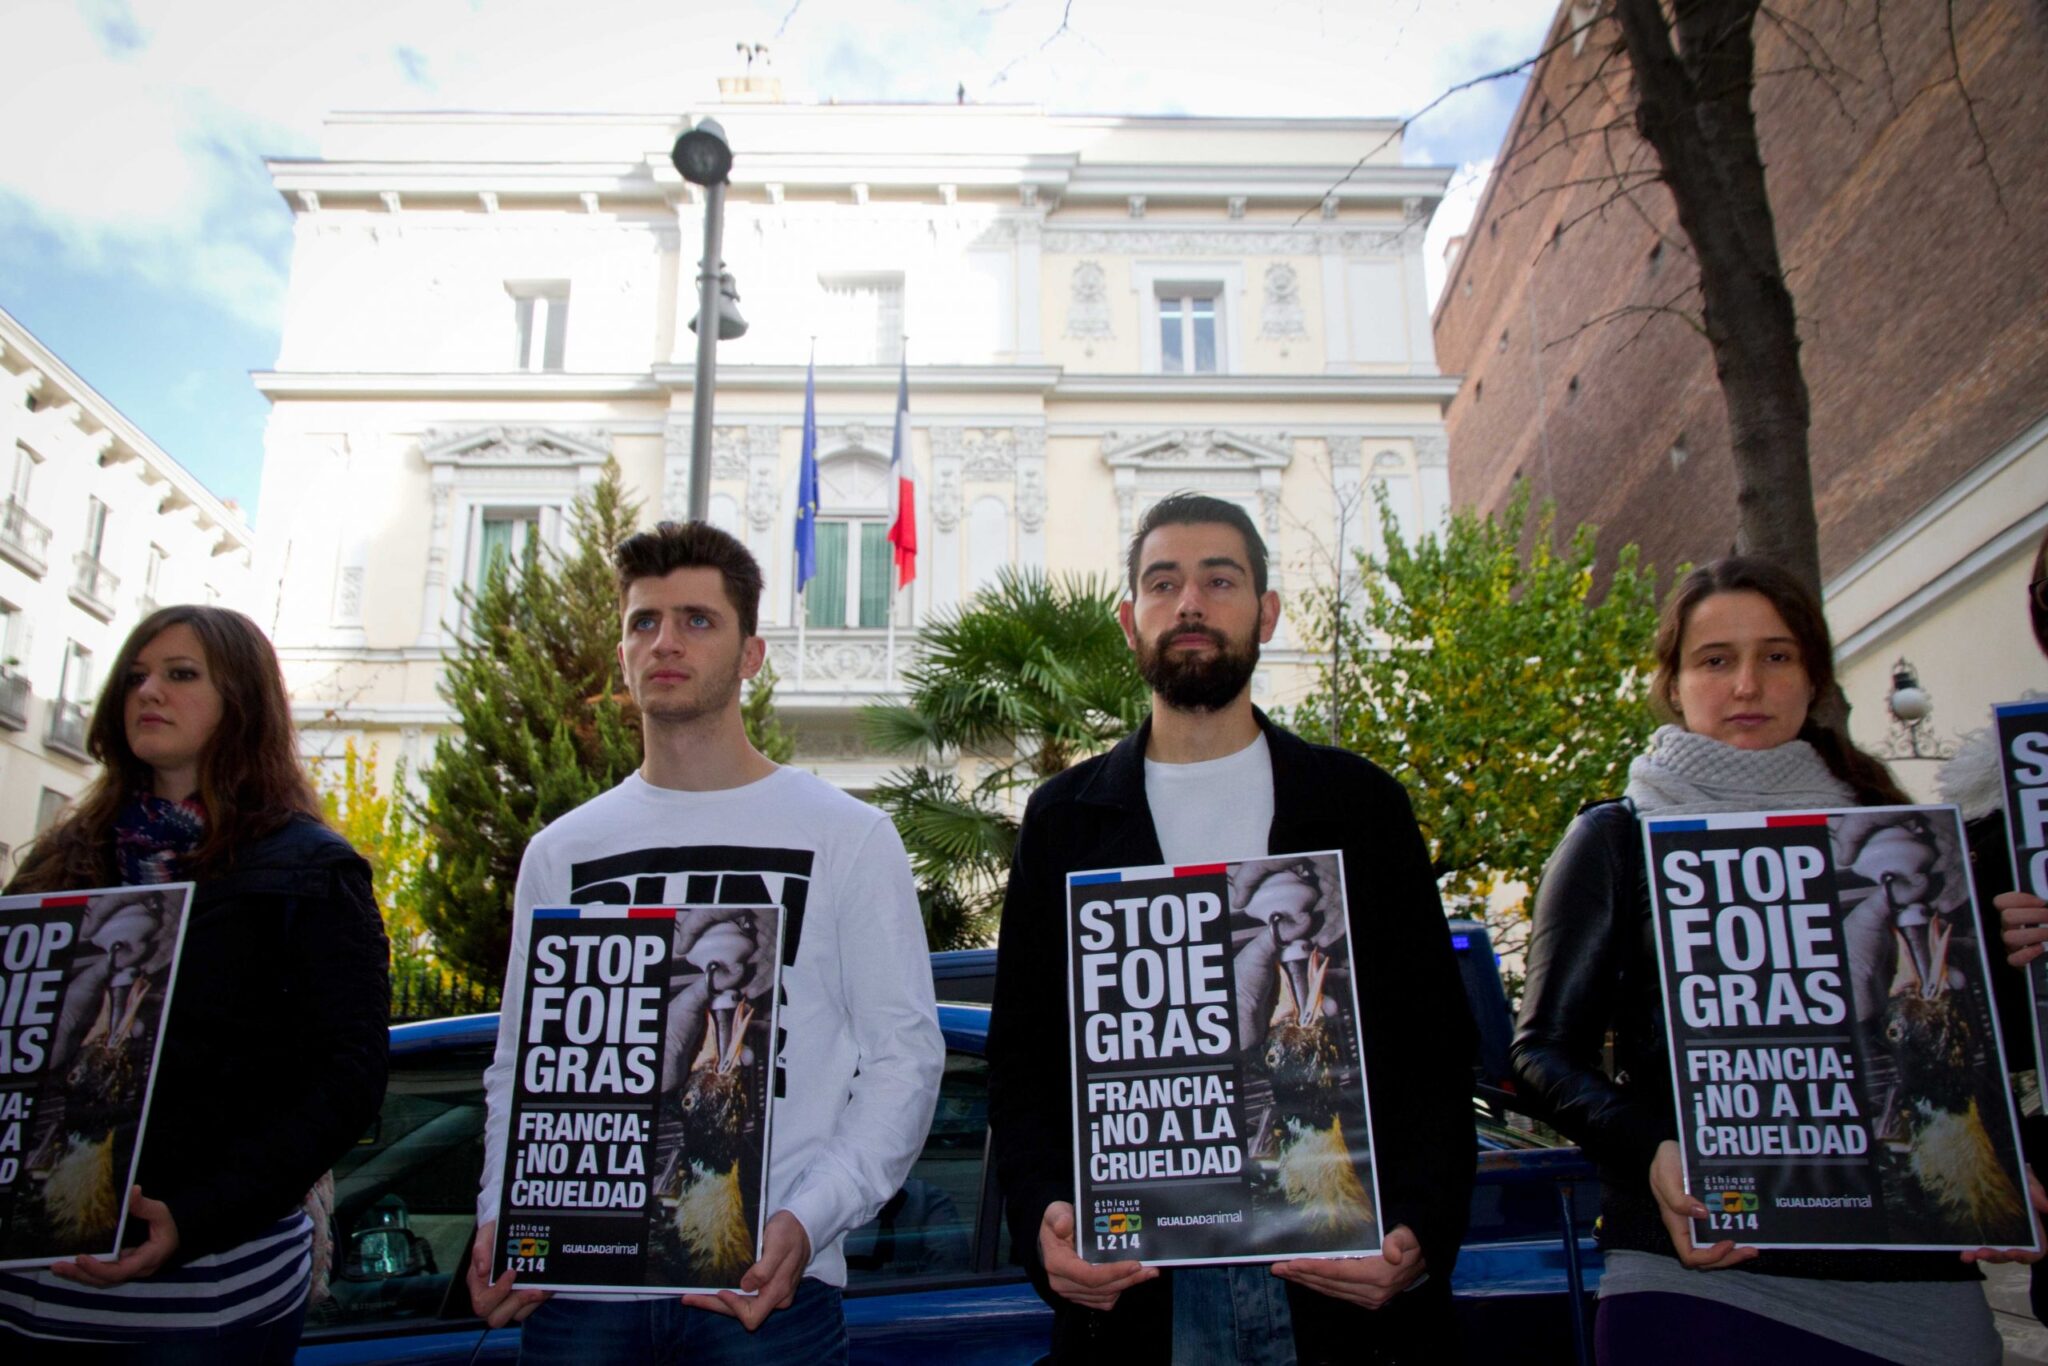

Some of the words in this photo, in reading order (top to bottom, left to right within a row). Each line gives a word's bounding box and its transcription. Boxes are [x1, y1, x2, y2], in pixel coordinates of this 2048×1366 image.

[1662, 845, 1826, 906] STOP
[1079, 892, 1223, 951] STOP
[1669, 903, 1840, 972] FOIE
[0, 921, 73, 972] OP
[534, 934, 666, 985] STOP
[0, 970, 63, 1027] IE
[1082, 943, 1228, 1012] FOIE
[1679, 970, 1846, 1029] GRAS
[527, 986, 661, 1044] FOIE
[1085, 1005, 1232, 1063] GRAS
[524, 1046, 656, 1094] GRAS
[1687, 1047, 1854, 1082] FRANCIA:
[1088, 1075, 1234, 1113] FRANCIA:
[1693, 1083, 1759, 1126] ¡NO
[1771, 1083, 1800, 1118] A
[1808, 1082, 1859, 1118] LA
[518, 1112, 650, 1142] FRANCIA:
[1091, 1112, 1149, 1153] ¡NO
[1159, 1110, 1183, 1142] A
[1193, 1106, 1236, 1140] LA
[1696, 1124, 1867, 1157] CRUELDAD
[516, 1143, 568, 1180] ¡NO
[576, 1145, 598, 1175] A
[607, 1145, 645, 1175] LA
[1090, 1145, 1242, 1182] CRUELDAD
[511, 1180, 647, 1208] CRUELDAD
[1097, 1234, 1141, 1250] L214
[1709, 1213, 1759, 1230] L214
